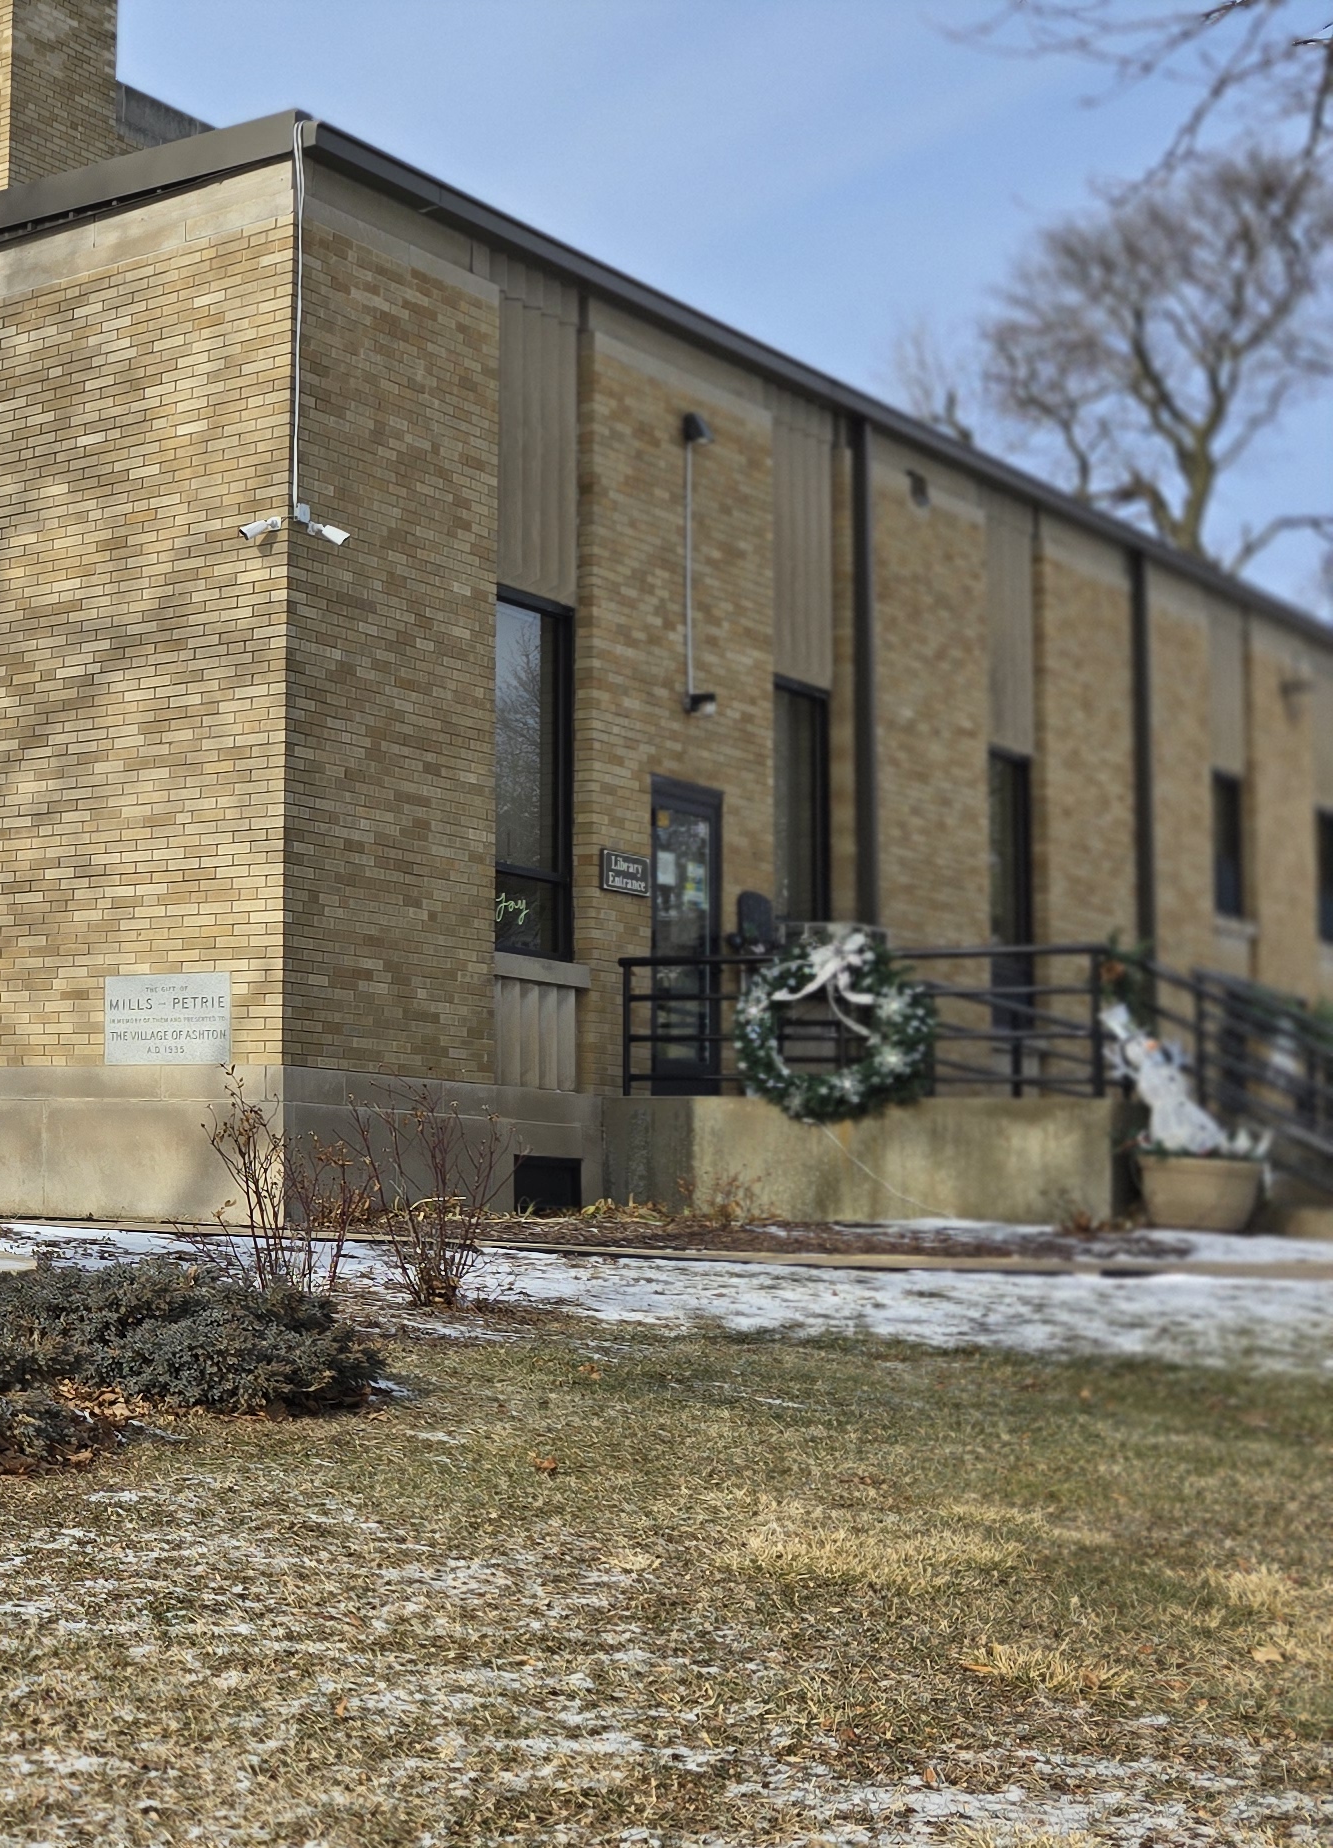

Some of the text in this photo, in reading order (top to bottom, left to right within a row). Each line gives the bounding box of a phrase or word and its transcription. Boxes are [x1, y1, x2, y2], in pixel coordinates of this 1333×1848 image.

[610, 855, 643, 877] Library
[608, 871, 646, 892] Entrance
[160, 985, 176, 993] GIFT
[109, 998, 153, 1011] MILLS
[172, 996, 225, 1009] PETRIE
[109, 1029, 227, 1041] THE VILLAGE OF ASHTON
